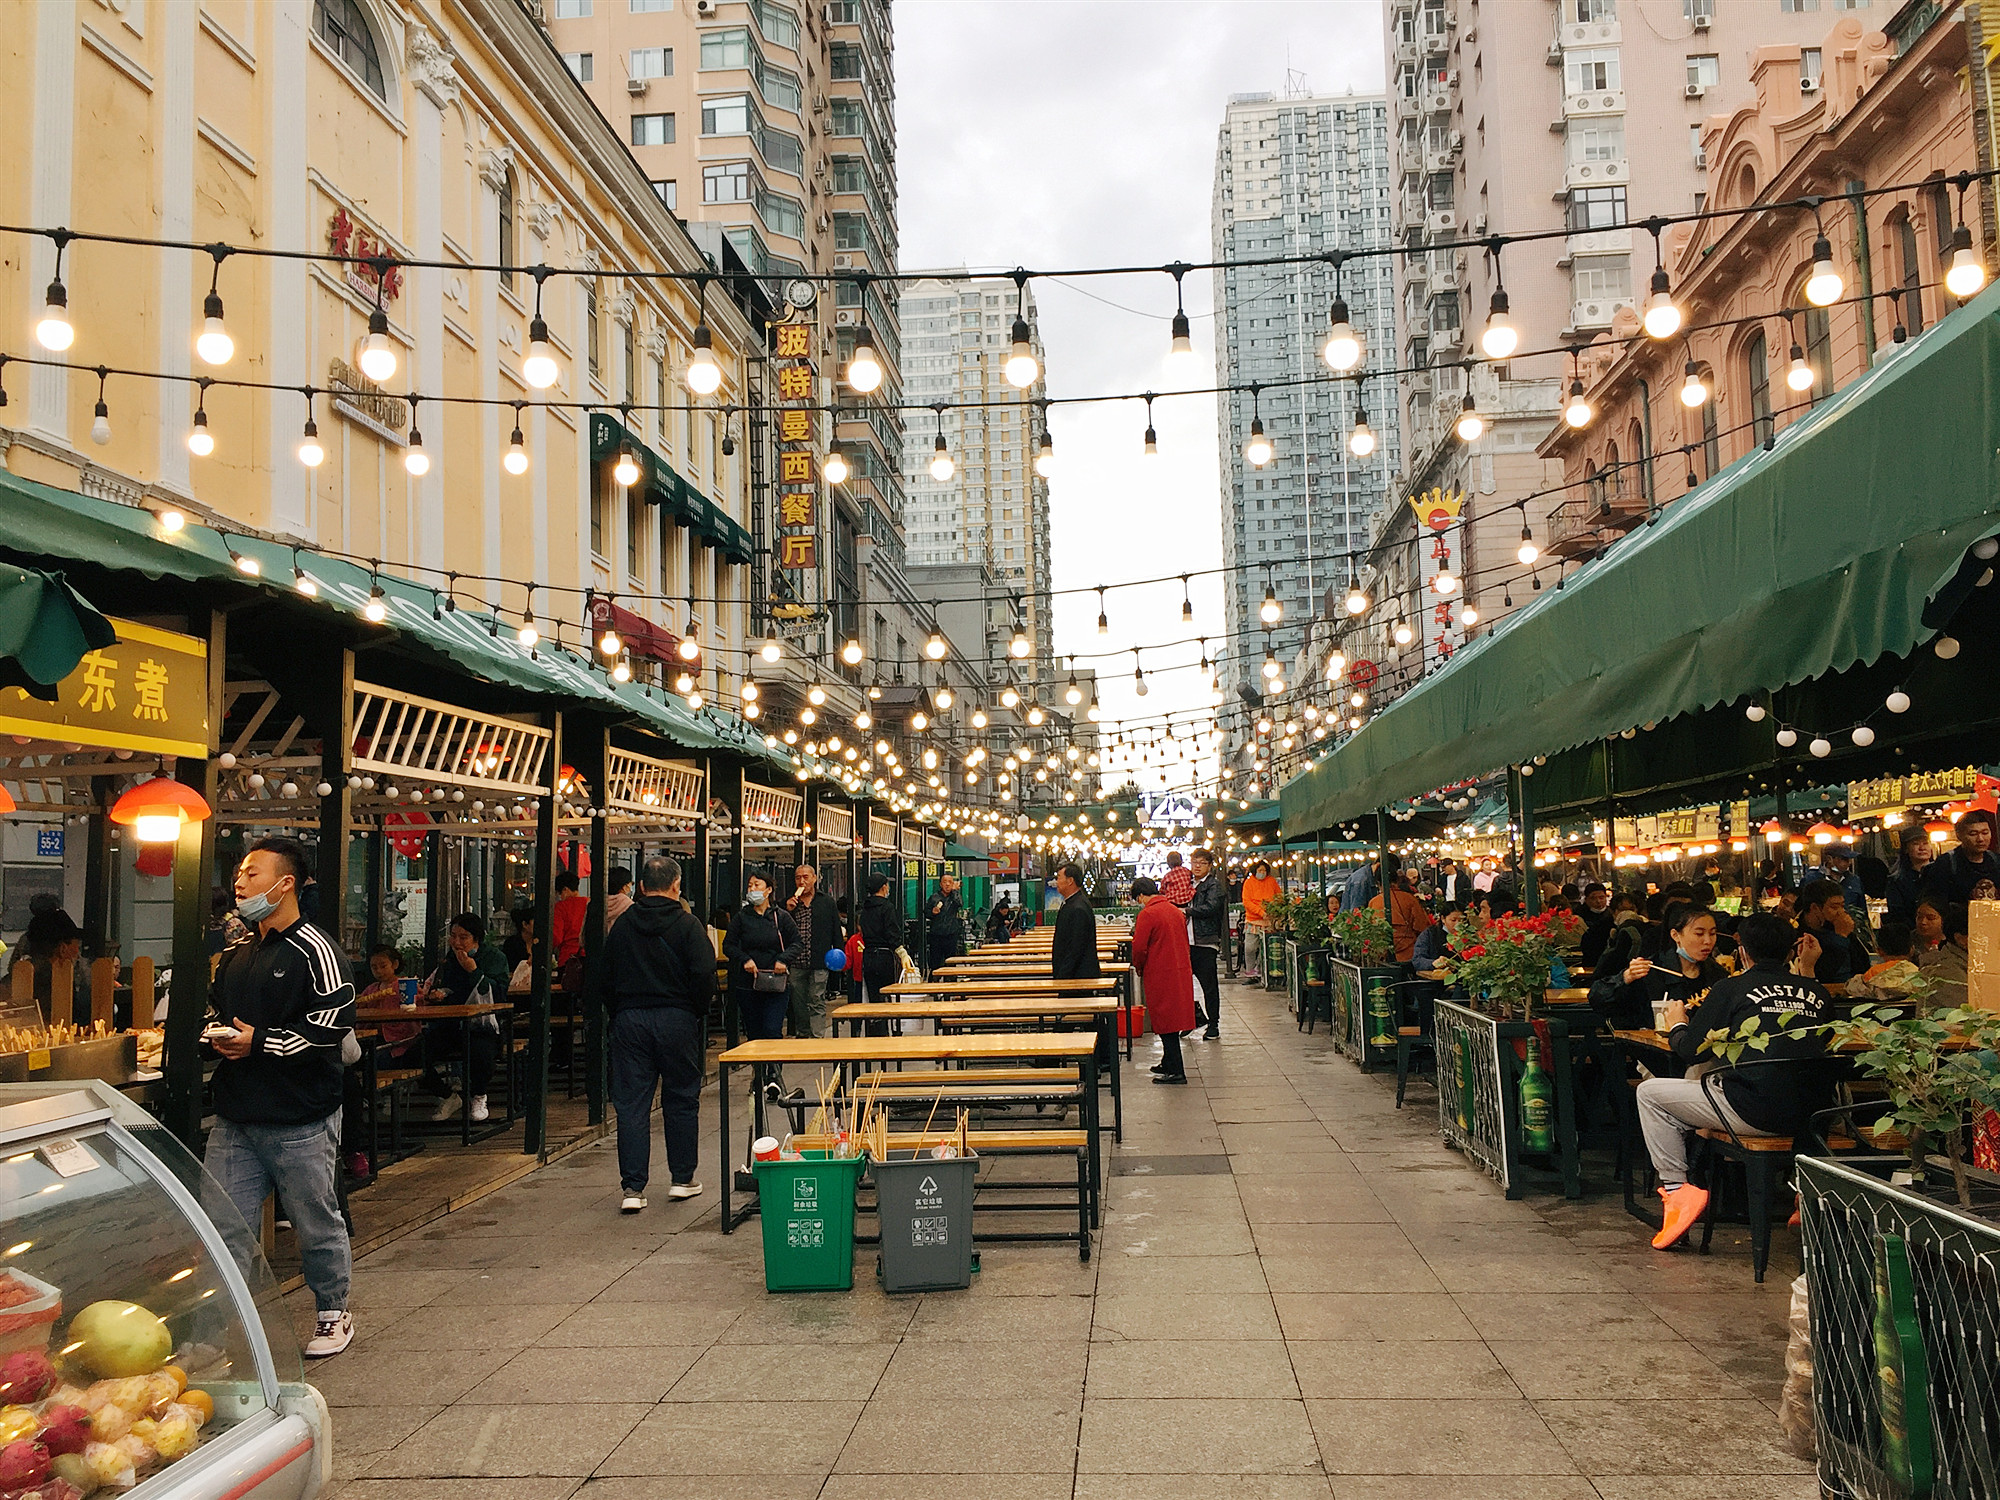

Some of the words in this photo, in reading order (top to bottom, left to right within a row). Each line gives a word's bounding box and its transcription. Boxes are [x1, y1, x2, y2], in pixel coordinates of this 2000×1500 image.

[778, 325, 814, 565] 波特曼西餐厅
[16, 648, 169, 724] 东煮
[41, 836, 60, 850] 55-2
[1746, 984, 1825, 1010] ALLSTARS
